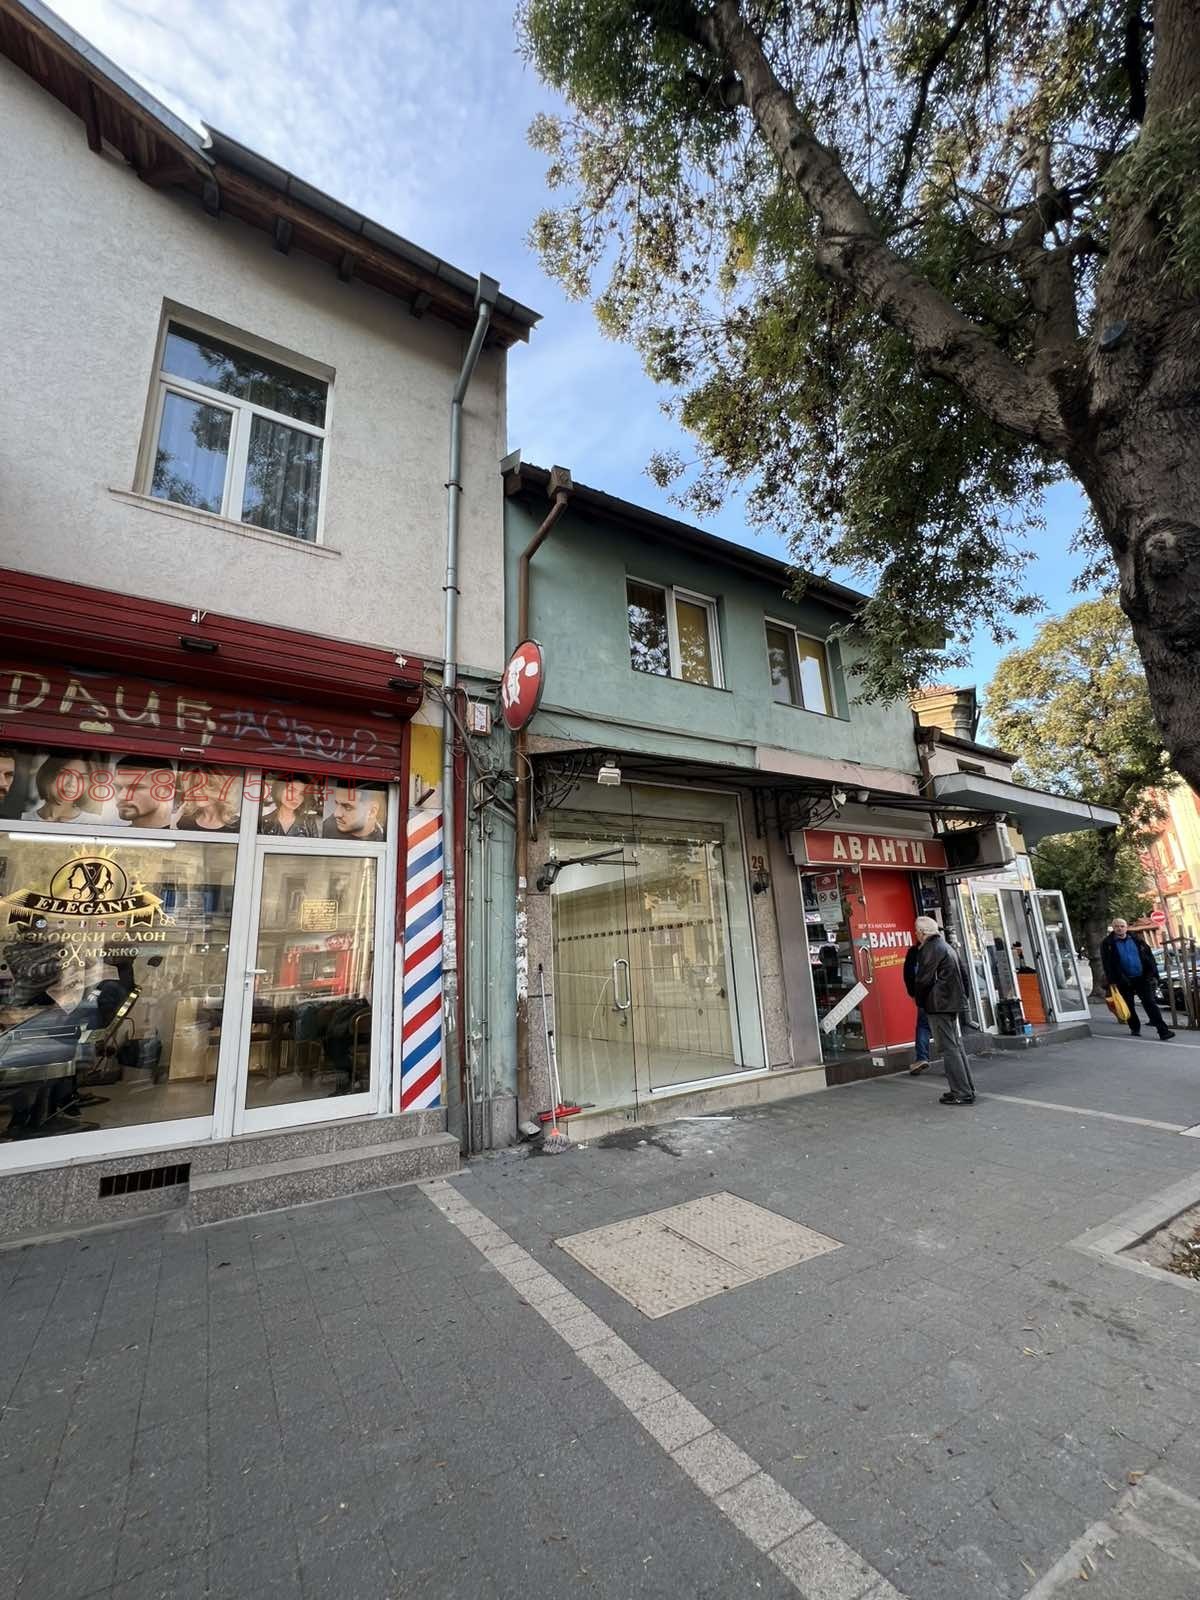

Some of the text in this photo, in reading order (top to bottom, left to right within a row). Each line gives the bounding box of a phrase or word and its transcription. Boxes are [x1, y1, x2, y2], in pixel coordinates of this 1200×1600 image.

[832, 834, 927, 864] АВАНТИ
[751, 855, 764, 871] 29
[34, 895, 137, 914] ELEGANT
[111, 931, 166, 942] САЛОН
